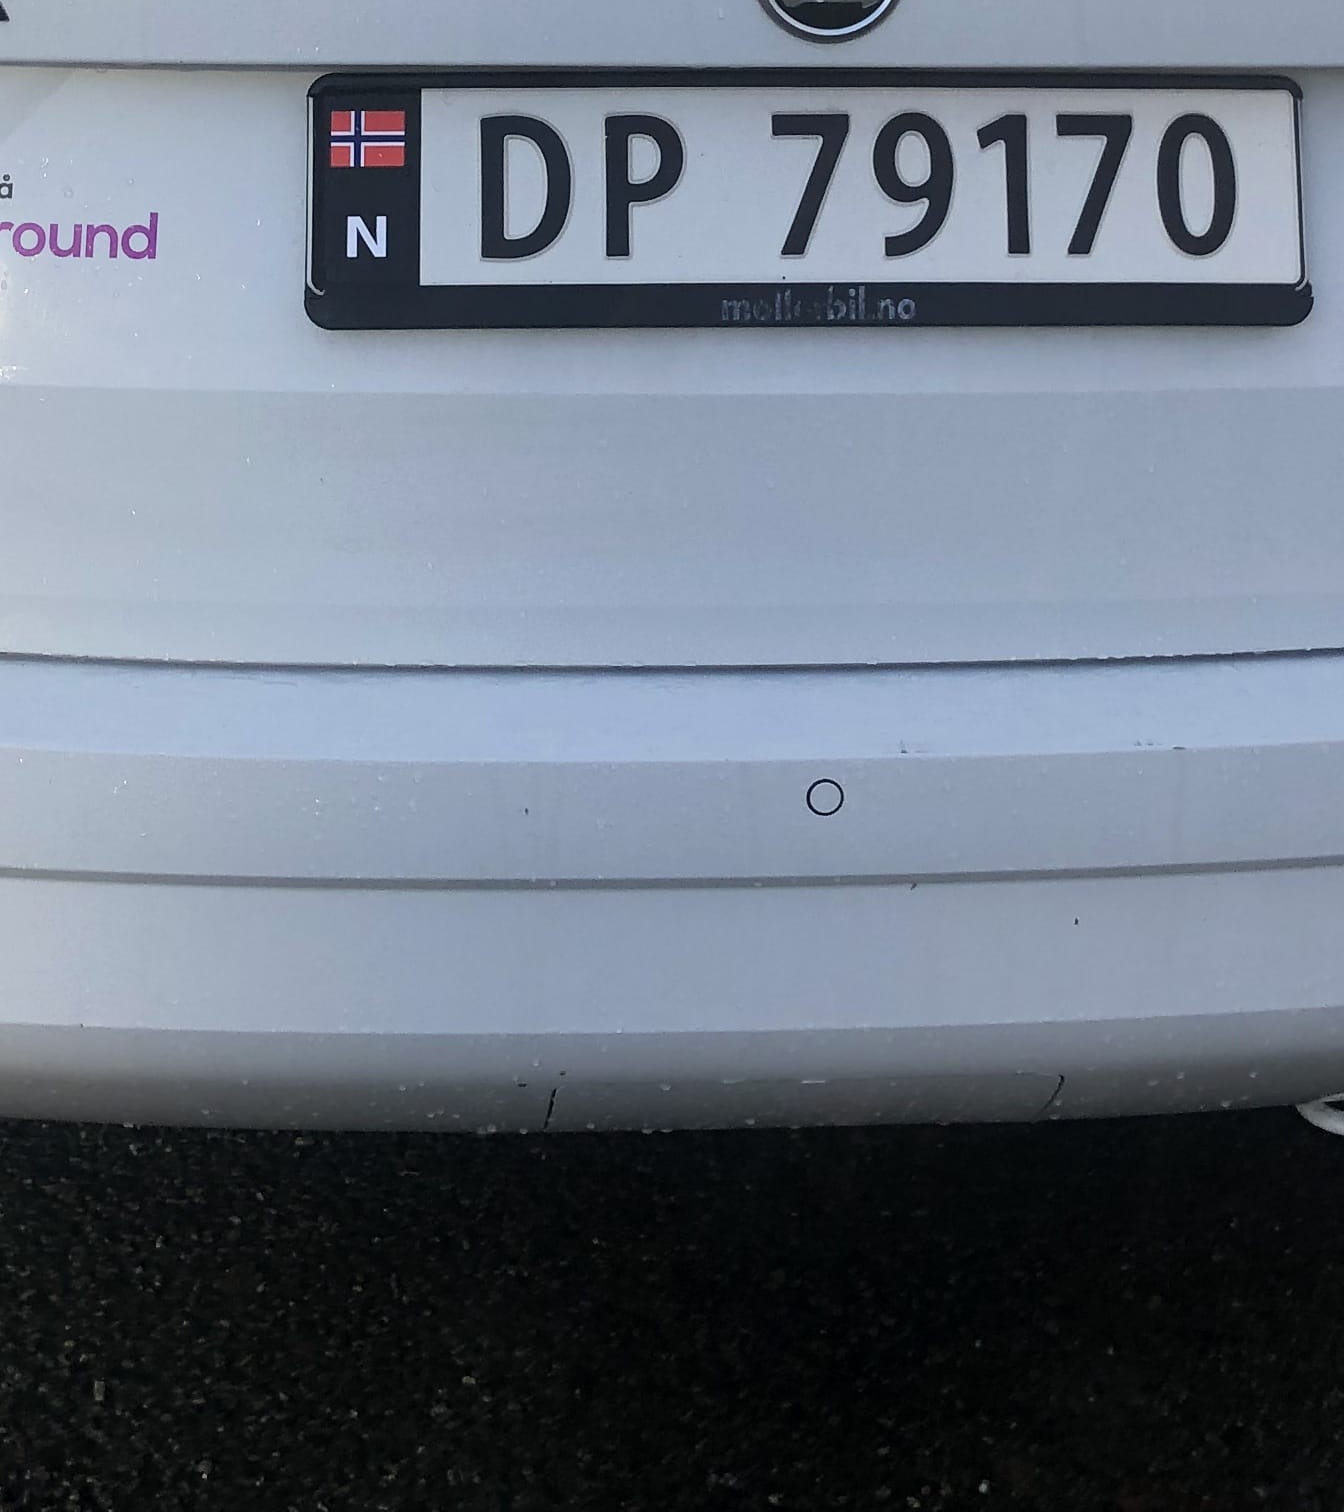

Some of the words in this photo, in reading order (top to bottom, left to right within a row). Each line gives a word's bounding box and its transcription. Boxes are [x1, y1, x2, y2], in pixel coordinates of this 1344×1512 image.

[478, 114, 685, 261] DP
[770, 113, 1237, 256] 79170
[346, 215, 387, 258] N
